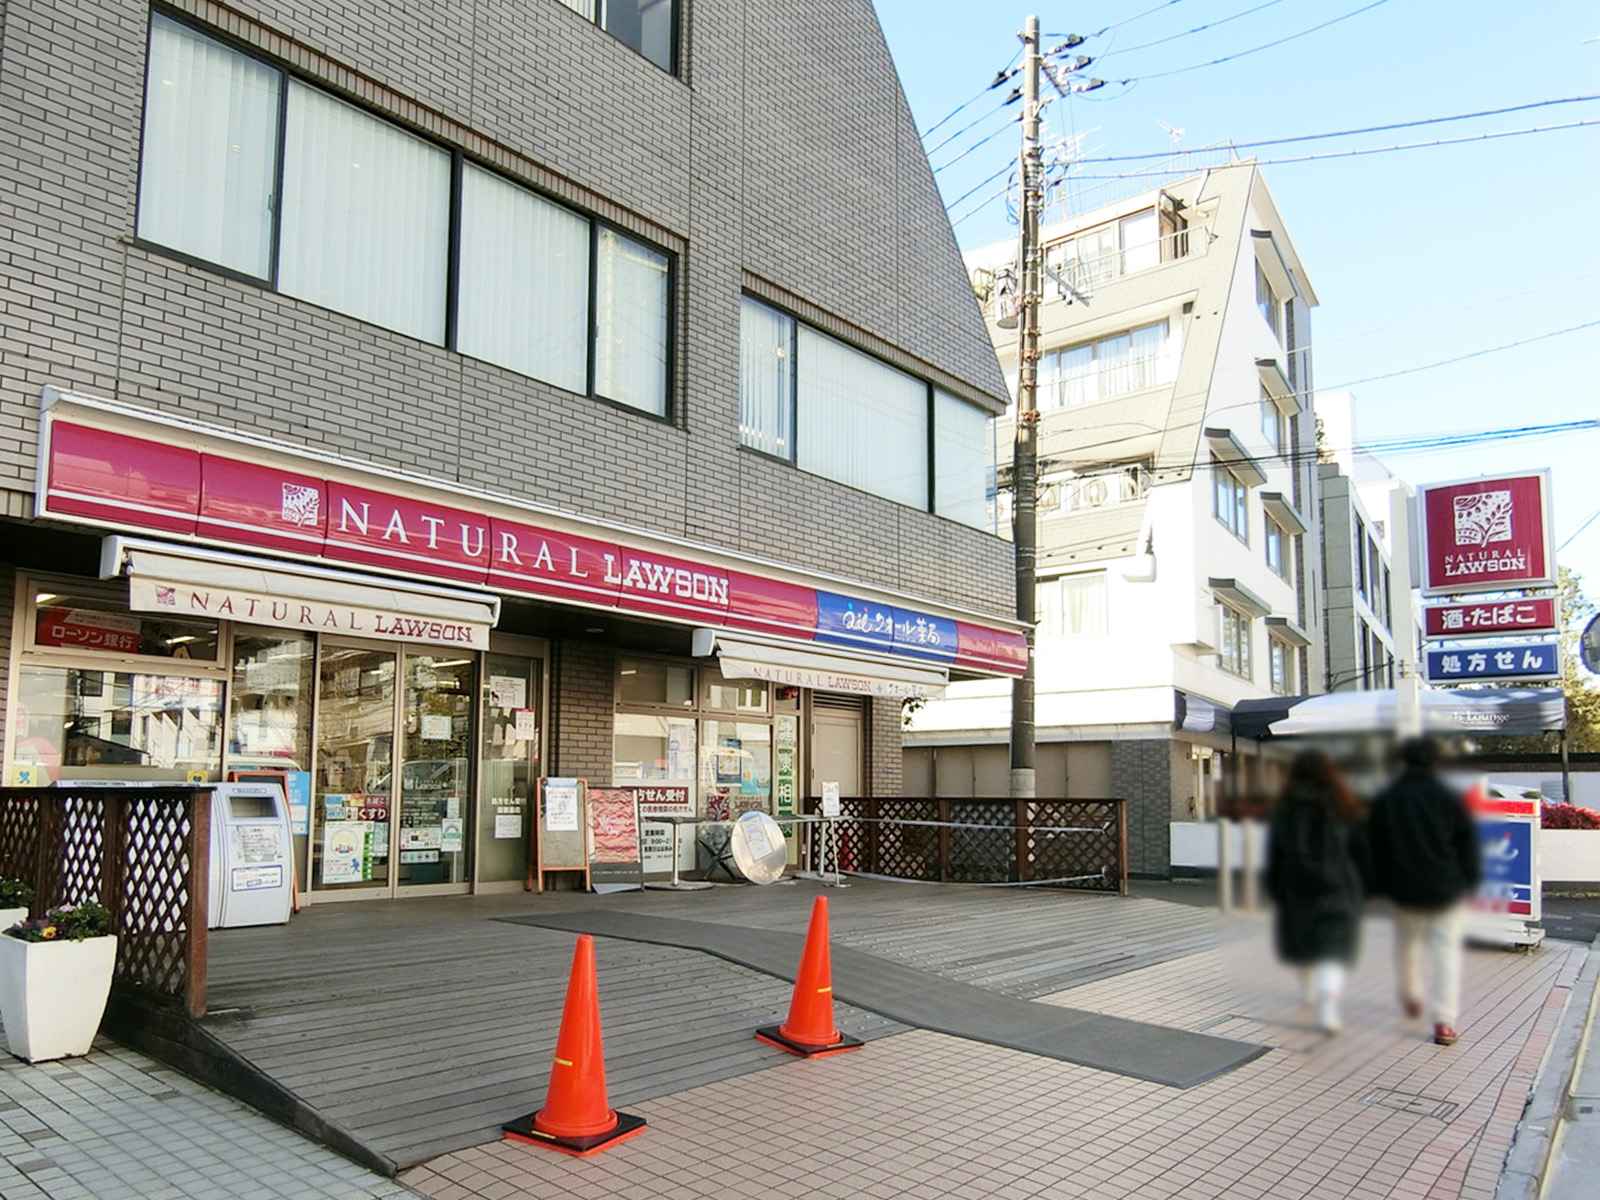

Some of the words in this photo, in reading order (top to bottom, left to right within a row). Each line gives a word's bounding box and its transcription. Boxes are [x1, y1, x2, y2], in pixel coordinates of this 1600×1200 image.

[337, 498, 588, 578] NATURAL
[603, 553, 729, 605] LAWSON
[1445, 549, 1526, 564] NATURAL
[1445, 557, 1526, 576] LAWSON
[190, 591, 362, 630] NATURAL
[374, 615, 473, 643] LAWSON
[874, 612, 940, 645] クオール薬局
[51, 625, 133, 649] ローソン銀行
[1441, 650, 1543, 674] 処方せん
[752, 667, 824, 687] NATURAL
[828, 675, 872, 693] LAWSON
[359, 808, 387, 820] くすり
